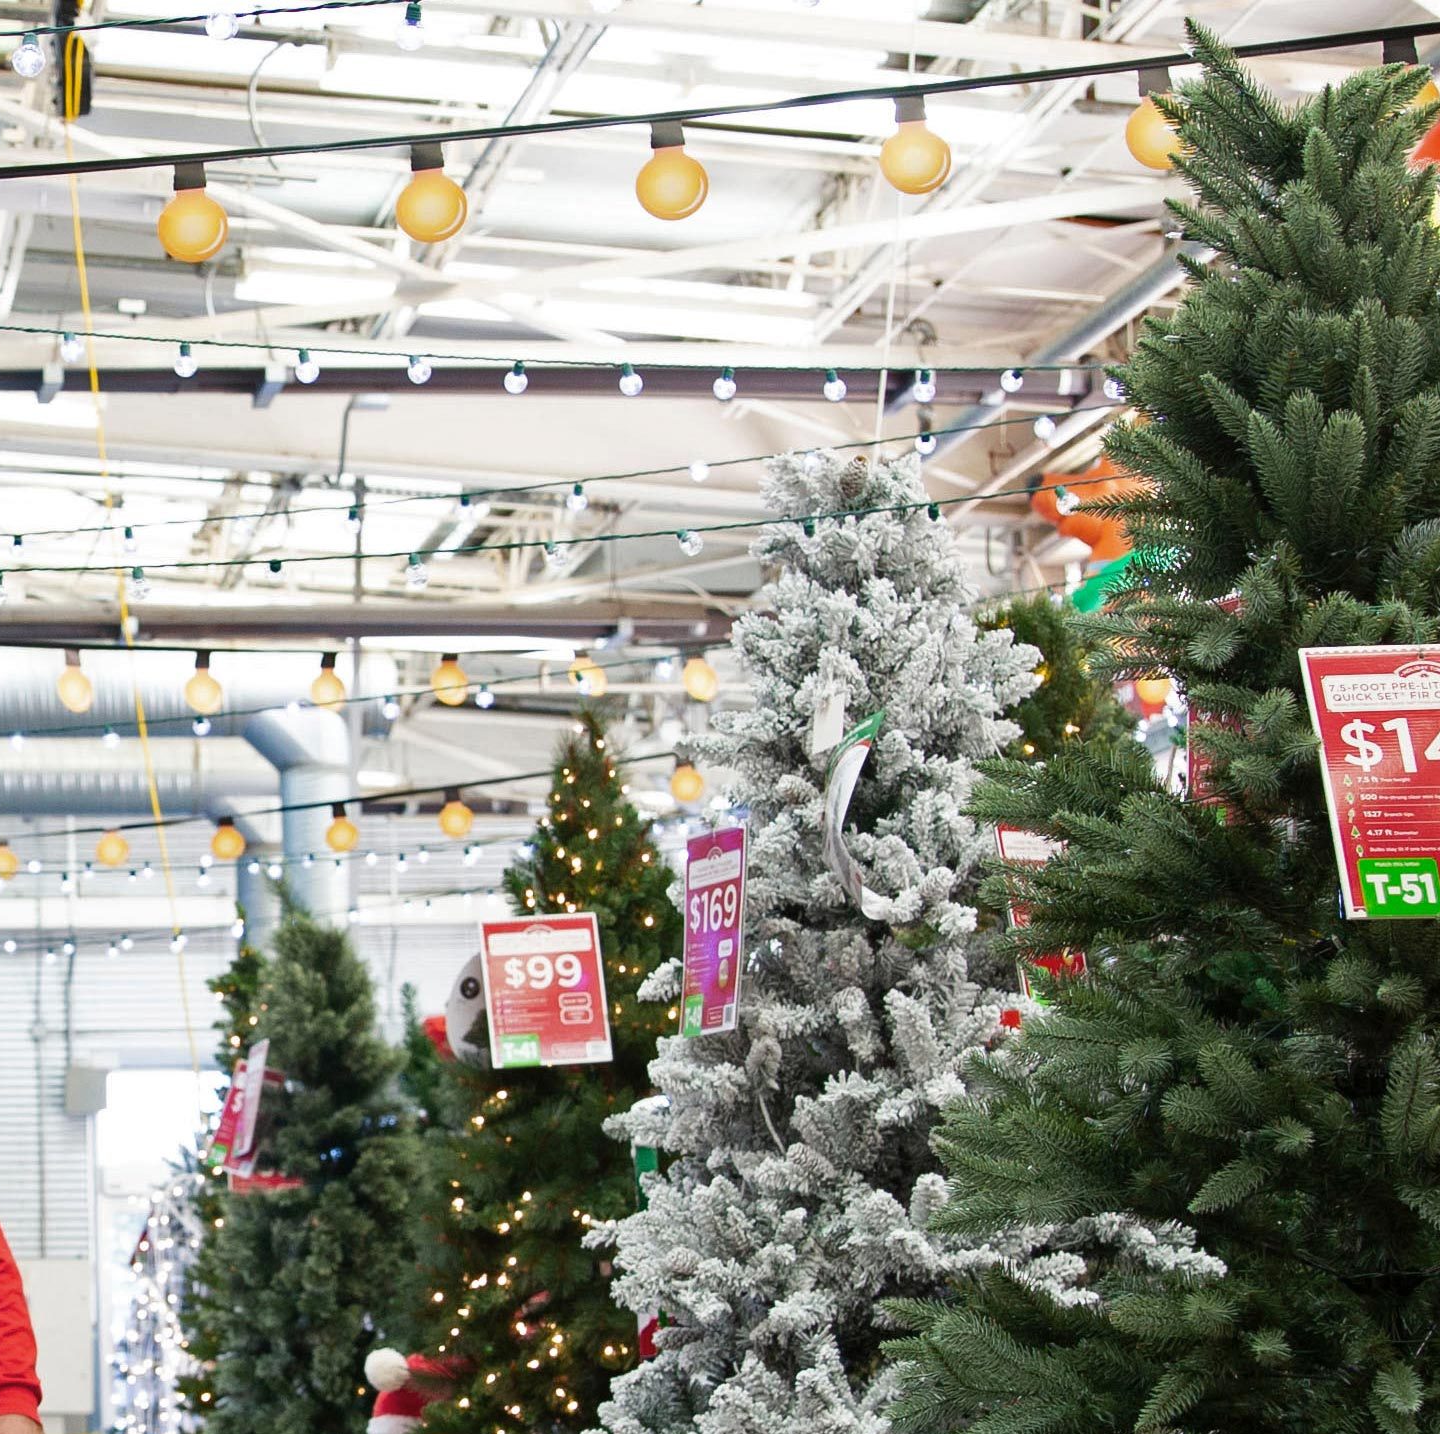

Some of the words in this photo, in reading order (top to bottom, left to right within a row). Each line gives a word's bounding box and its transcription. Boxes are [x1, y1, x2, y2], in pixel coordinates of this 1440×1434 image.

[1328, 682, 1387, 693] 7.5-FOOT
[1391, 681, 1440, 691] PRE-LIT
[1332, 692, 1373, 702] QUICK
[1410, 691, 1430, 700] FIR
[1360, 793, 1378, 801] 500
[1366, 872, 1437, 905] T-51
[689, 883, 738, 935] $169
[504, 953, 582, 990] $99
